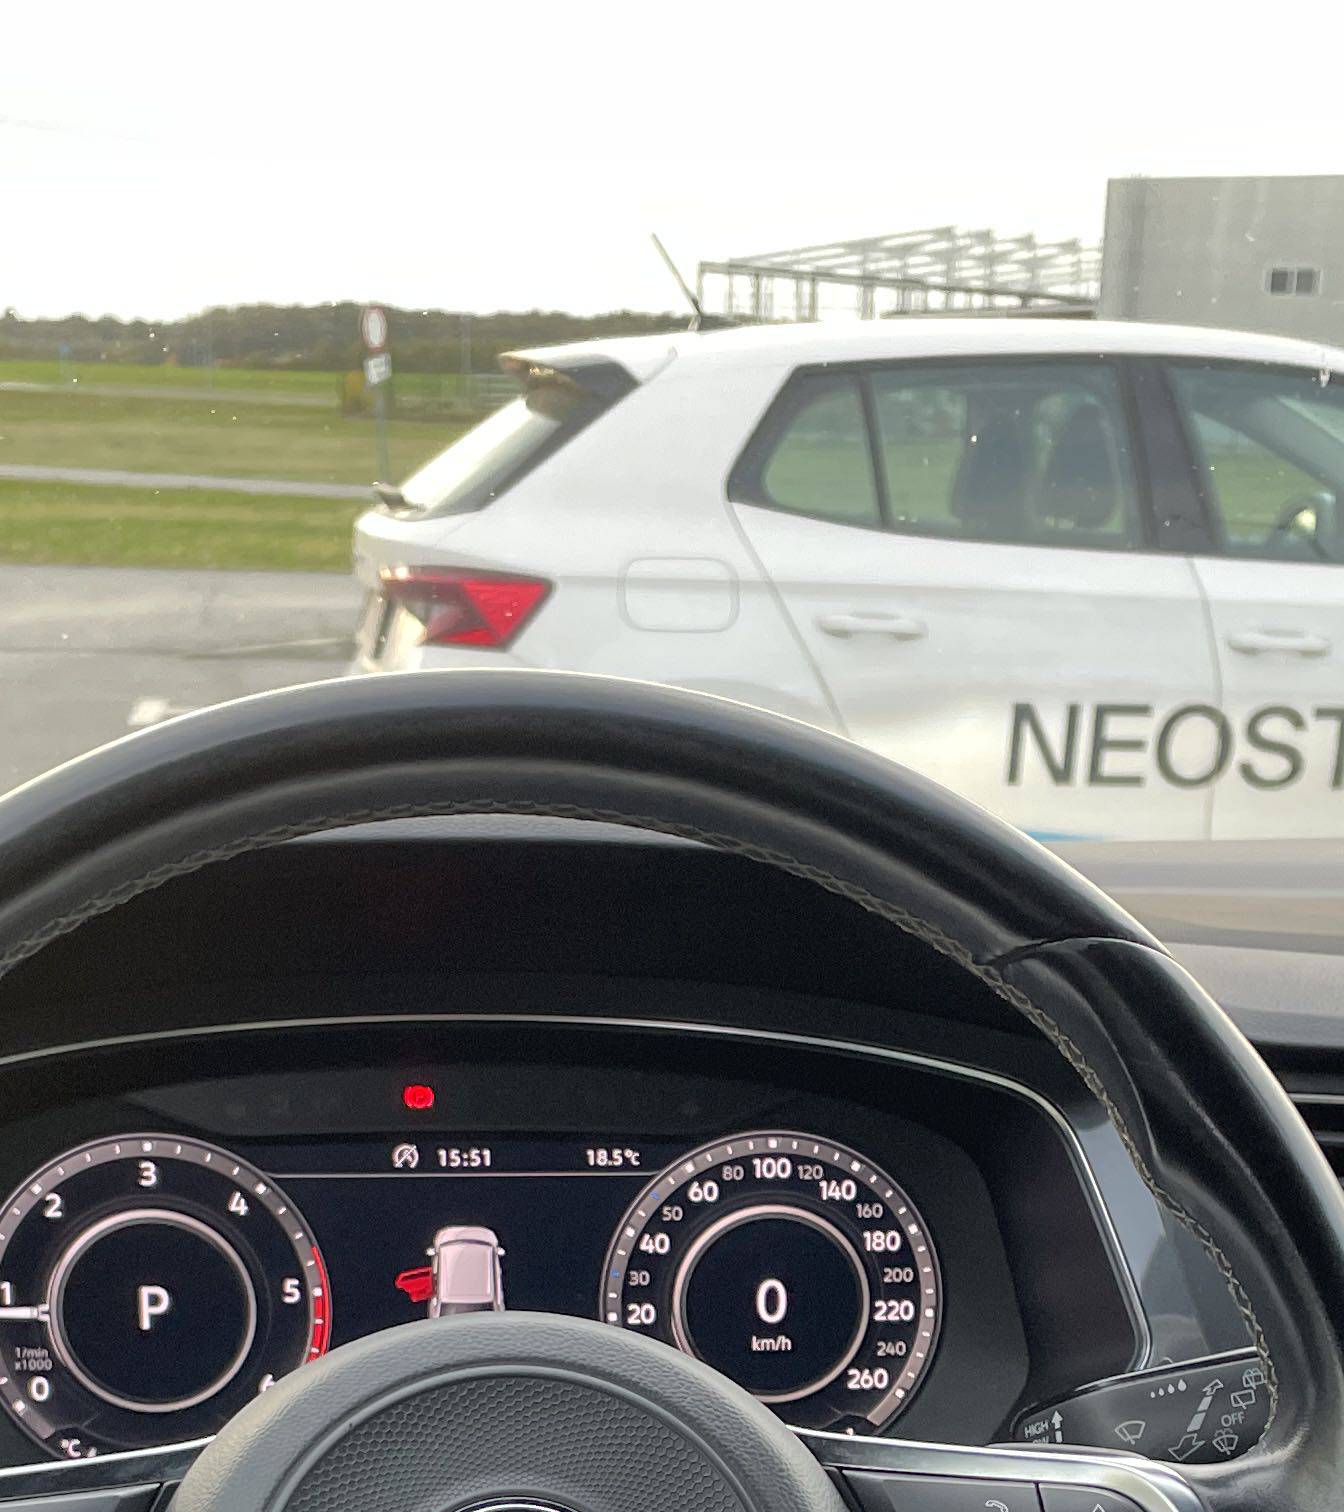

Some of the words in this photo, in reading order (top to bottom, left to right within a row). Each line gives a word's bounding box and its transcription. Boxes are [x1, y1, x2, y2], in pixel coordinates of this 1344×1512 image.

[437, 1148, 492, 1168] 15:51
[752, 1157, 792, 1180] 100
[137, 1160, 158, 1188] 3
[722, 1164, 744, 1182] 80
[797, 1163, 824, 1181] 120
[687, 1180, 719, 1203] 60
[818, 1180, 857, 1201] 140
[43, 1193, 64, 1219] 2
[227, 1192, 249, 1217] 4
[661, 1204, 684, 1222] 50
[856, 1202, 884, 1219] 160
[639, 1232, 671, 1255] 40
[863, 1230, 902, 1253] 180
[628, 1270, 651, 1287] 30
[883, 1266, 914, 1284] 200
[281, 1279, 301, 1304] 5
[756, 1277, 789, 1325] 0
[137, 1285, 170, 1331] P
[626, 1303, 657, 1327] 20
[873, 1300, 915, 1323] 220
[15, 1346, 49, 1359] 1/min
[751, 1334, 793, 1352] km/h
[876, 1340, 908, 1358] 240
[28, 1375, 50, 1402] 0
[846, 1367, 889, 1391] 260
[1024, 1420, 1049, 1439] HIGH
[1220, 1411, 1245, 1428] OFF
